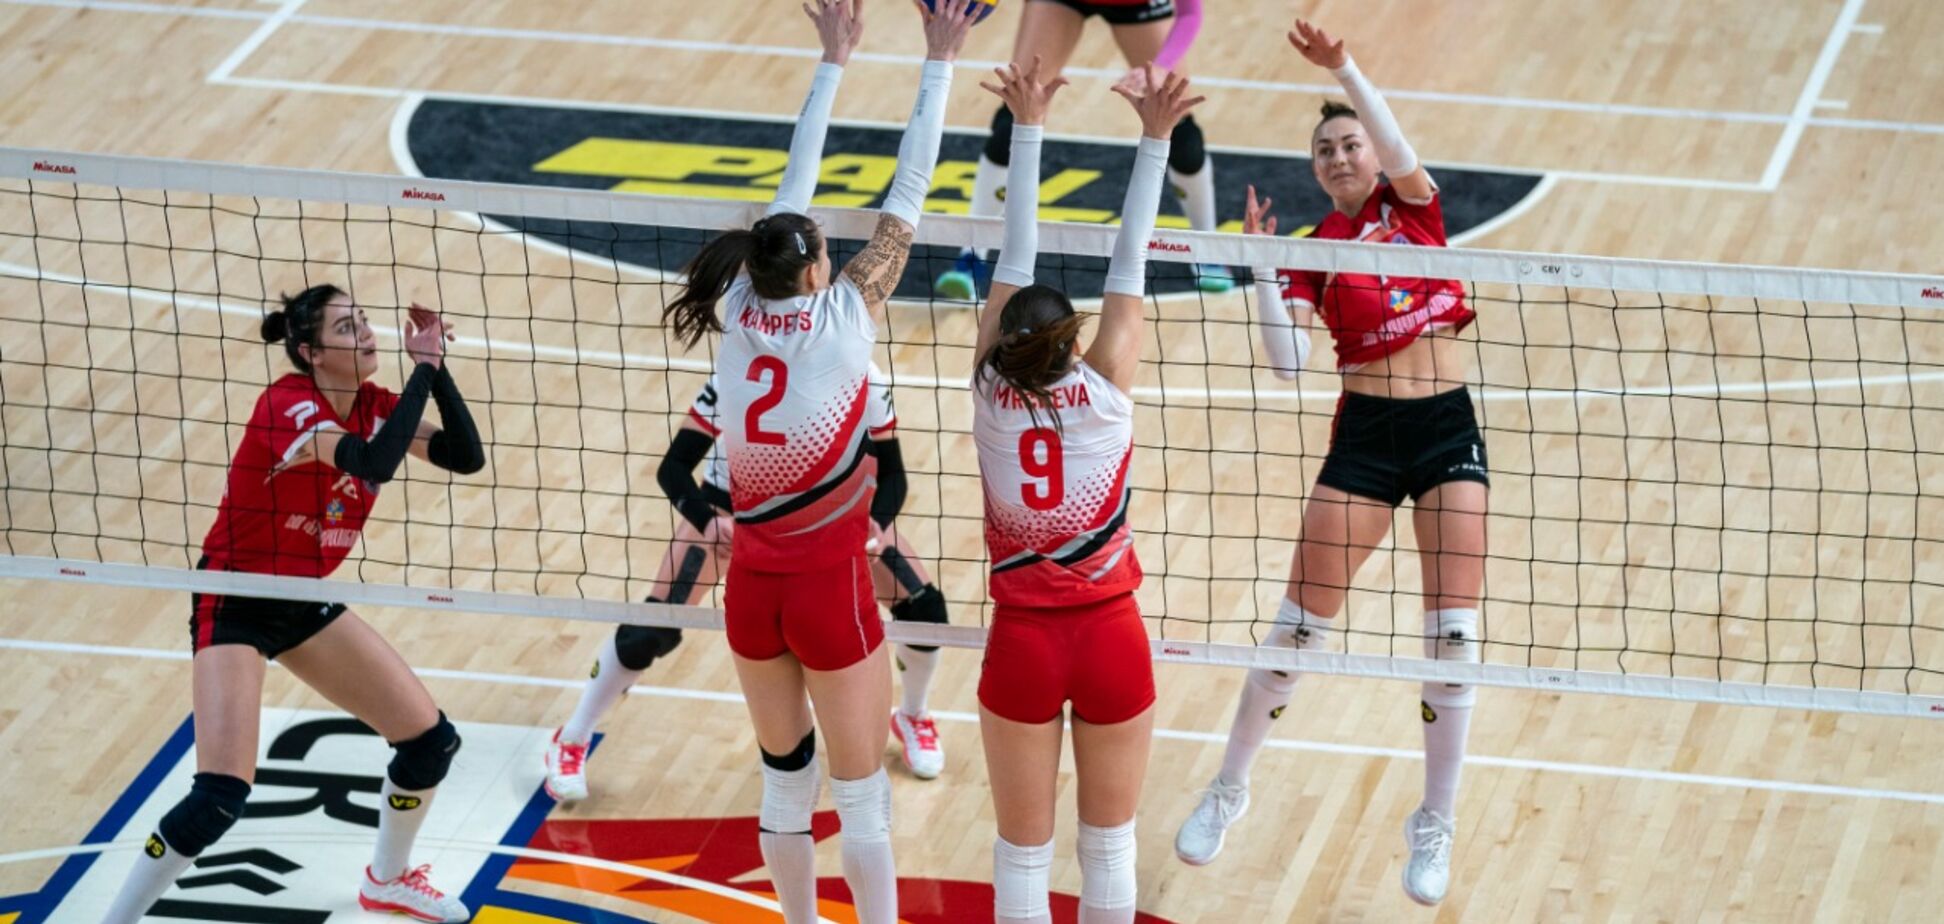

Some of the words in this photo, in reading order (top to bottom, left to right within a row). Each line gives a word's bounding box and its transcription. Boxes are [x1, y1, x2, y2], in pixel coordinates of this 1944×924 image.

[1541, 264, 1561, 274] CEV
[745, 354, 788, 446] 2
[1019, 427, 1065, 512] 9
